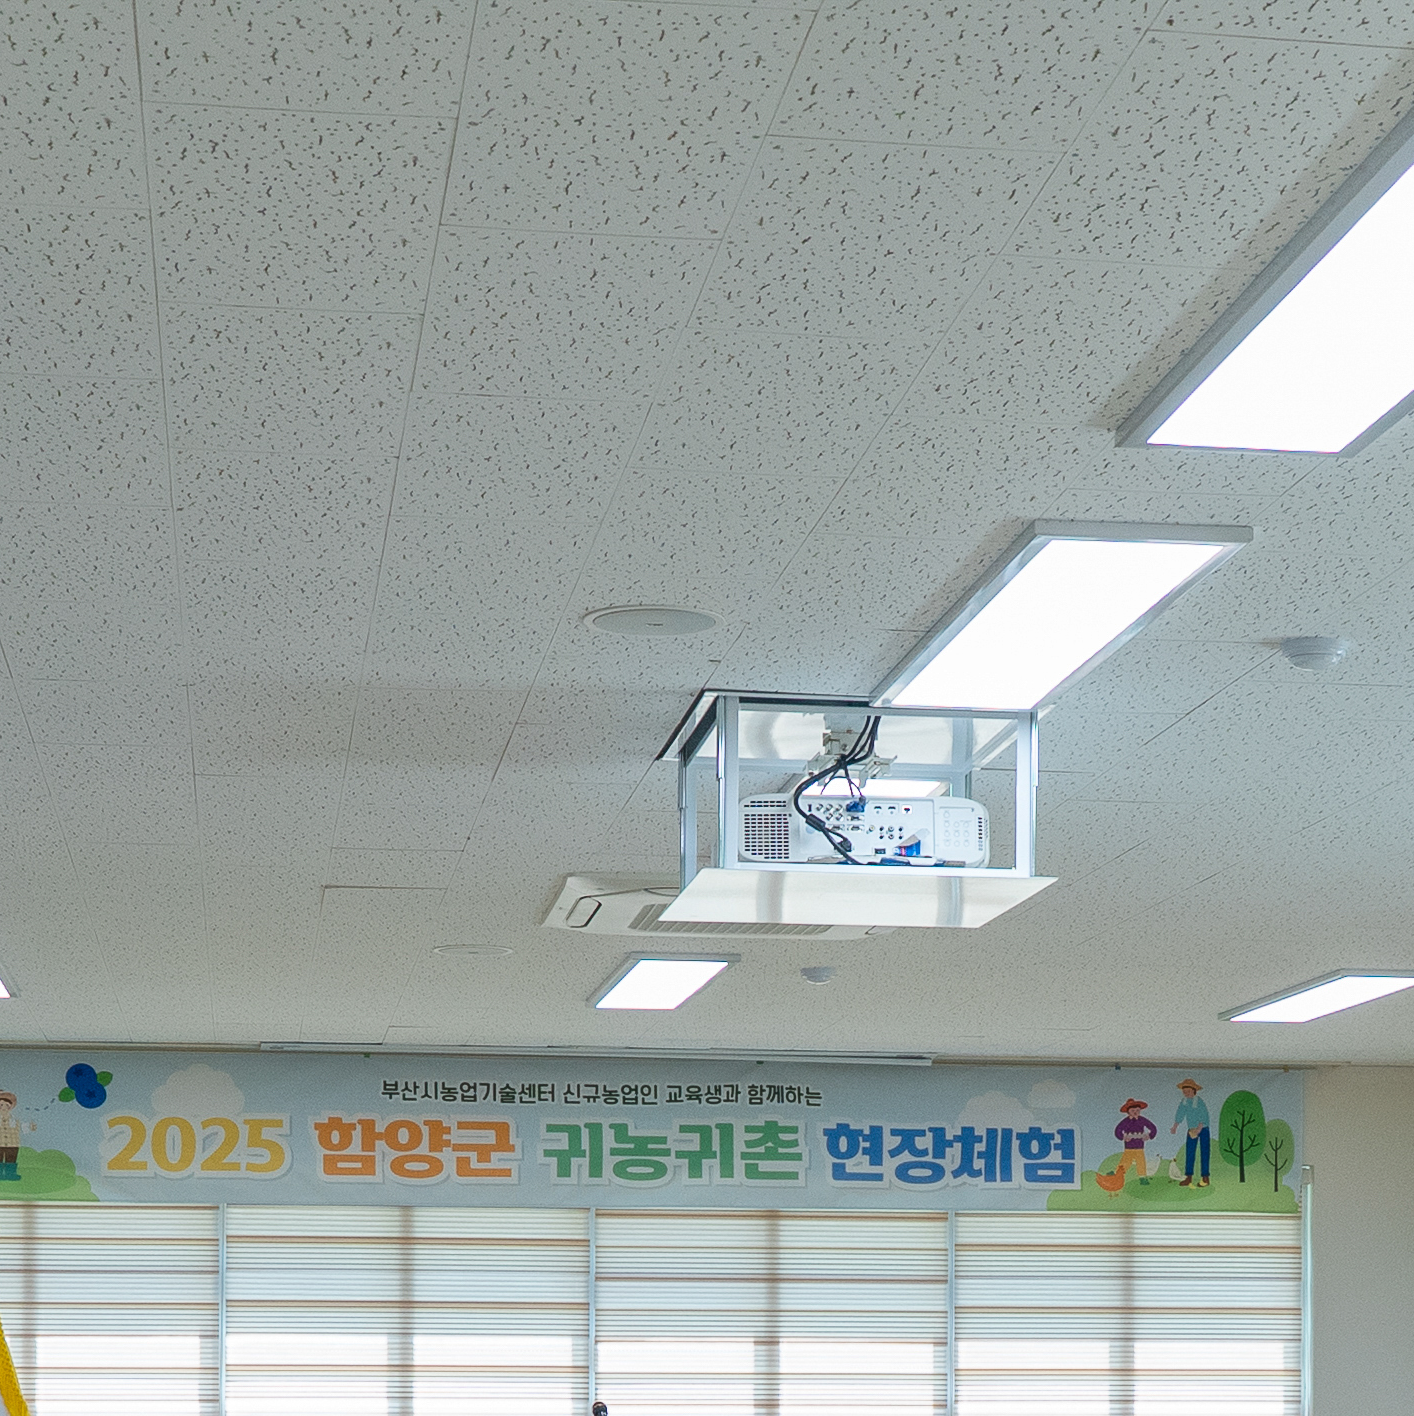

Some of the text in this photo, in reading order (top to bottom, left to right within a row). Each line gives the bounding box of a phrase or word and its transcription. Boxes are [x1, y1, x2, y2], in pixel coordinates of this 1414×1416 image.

[381, 1080, 823, 1107] 부산시농업기술센터 신규농업인 교육생과 함께하는
[105, 1115, 1076, 1185] 2025 함양군 귀농귀촌 현장체험
